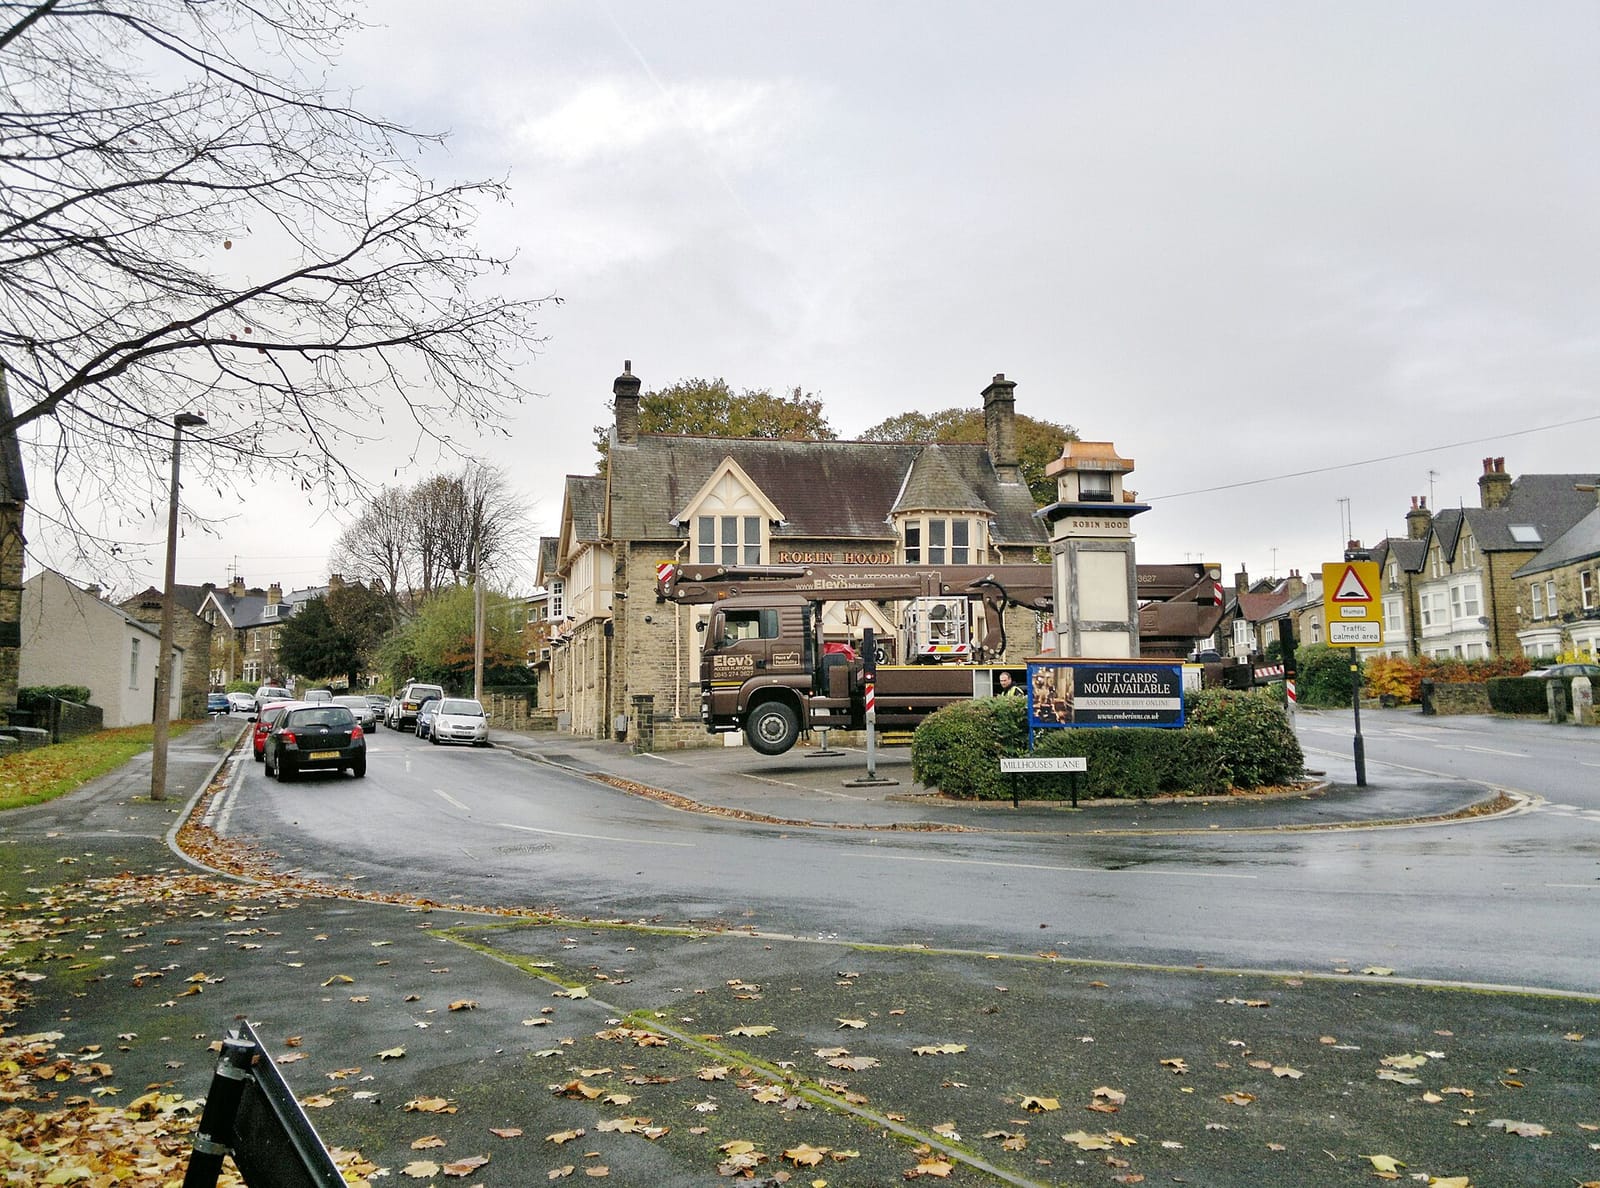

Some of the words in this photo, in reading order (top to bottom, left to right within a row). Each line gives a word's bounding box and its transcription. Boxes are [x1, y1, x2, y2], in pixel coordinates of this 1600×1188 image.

[1072, 520, 1100, 529] ROBIN
[1104, 521, 1128, 529] HOOD
[778, 551, 833, 564] ROBIN
[844, 551, 892, 565] HOOD
[1137, 574, 1157, 583] 3627
[713, 654, 754, 667] Elev8
[1096, 672, 1120, 683] GIFT
[1122, 672, 1158, 683] CARDS
[1084, 683, 1110, 694] NOW
[1112, 683, 1171, 694] AVAILABLE
[1003, 760, 1053, 769] MILLHOUSES
[1056, 760, 1080, 769] LANE
